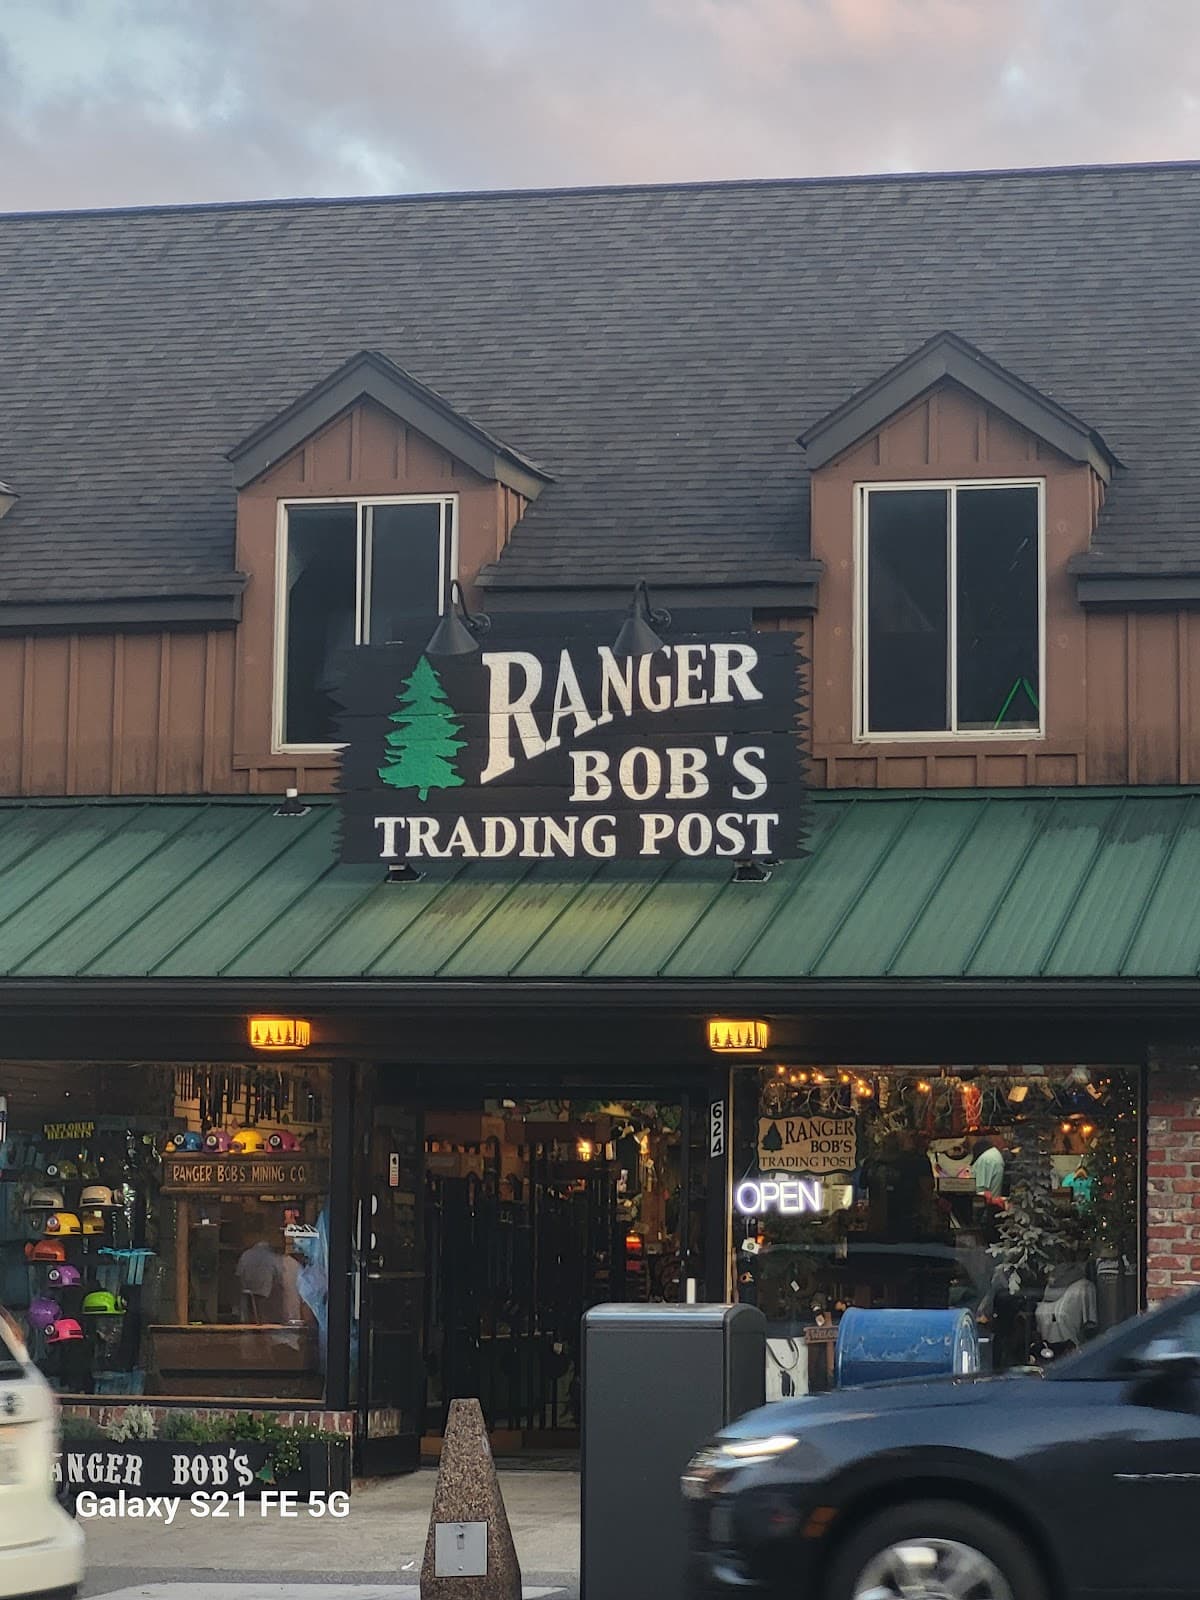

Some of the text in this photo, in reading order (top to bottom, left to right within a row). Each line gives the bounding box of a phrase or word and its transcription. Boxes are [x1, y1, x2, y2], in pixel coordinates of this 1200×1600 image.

[480, 643, 764, 784] RANGER
[568, 735, 768, 802] BOB'S
[374, 812, 779, 858] TRADING POST
[712, 1103, 722, 1153] 624
[784, 1119, 854, 1145] RANGER
[760, 1156, 853, 1168] TRADING POST
[810, 1140, 853, 1154] BOB'S
[173, 1165, 213, 1182] RANGER
[252, 1165, 285, 1183] MINING
[736, 1181, 822, 1213] OPEN
[50, 1448, 254, 1487] ANGER BOB'S
